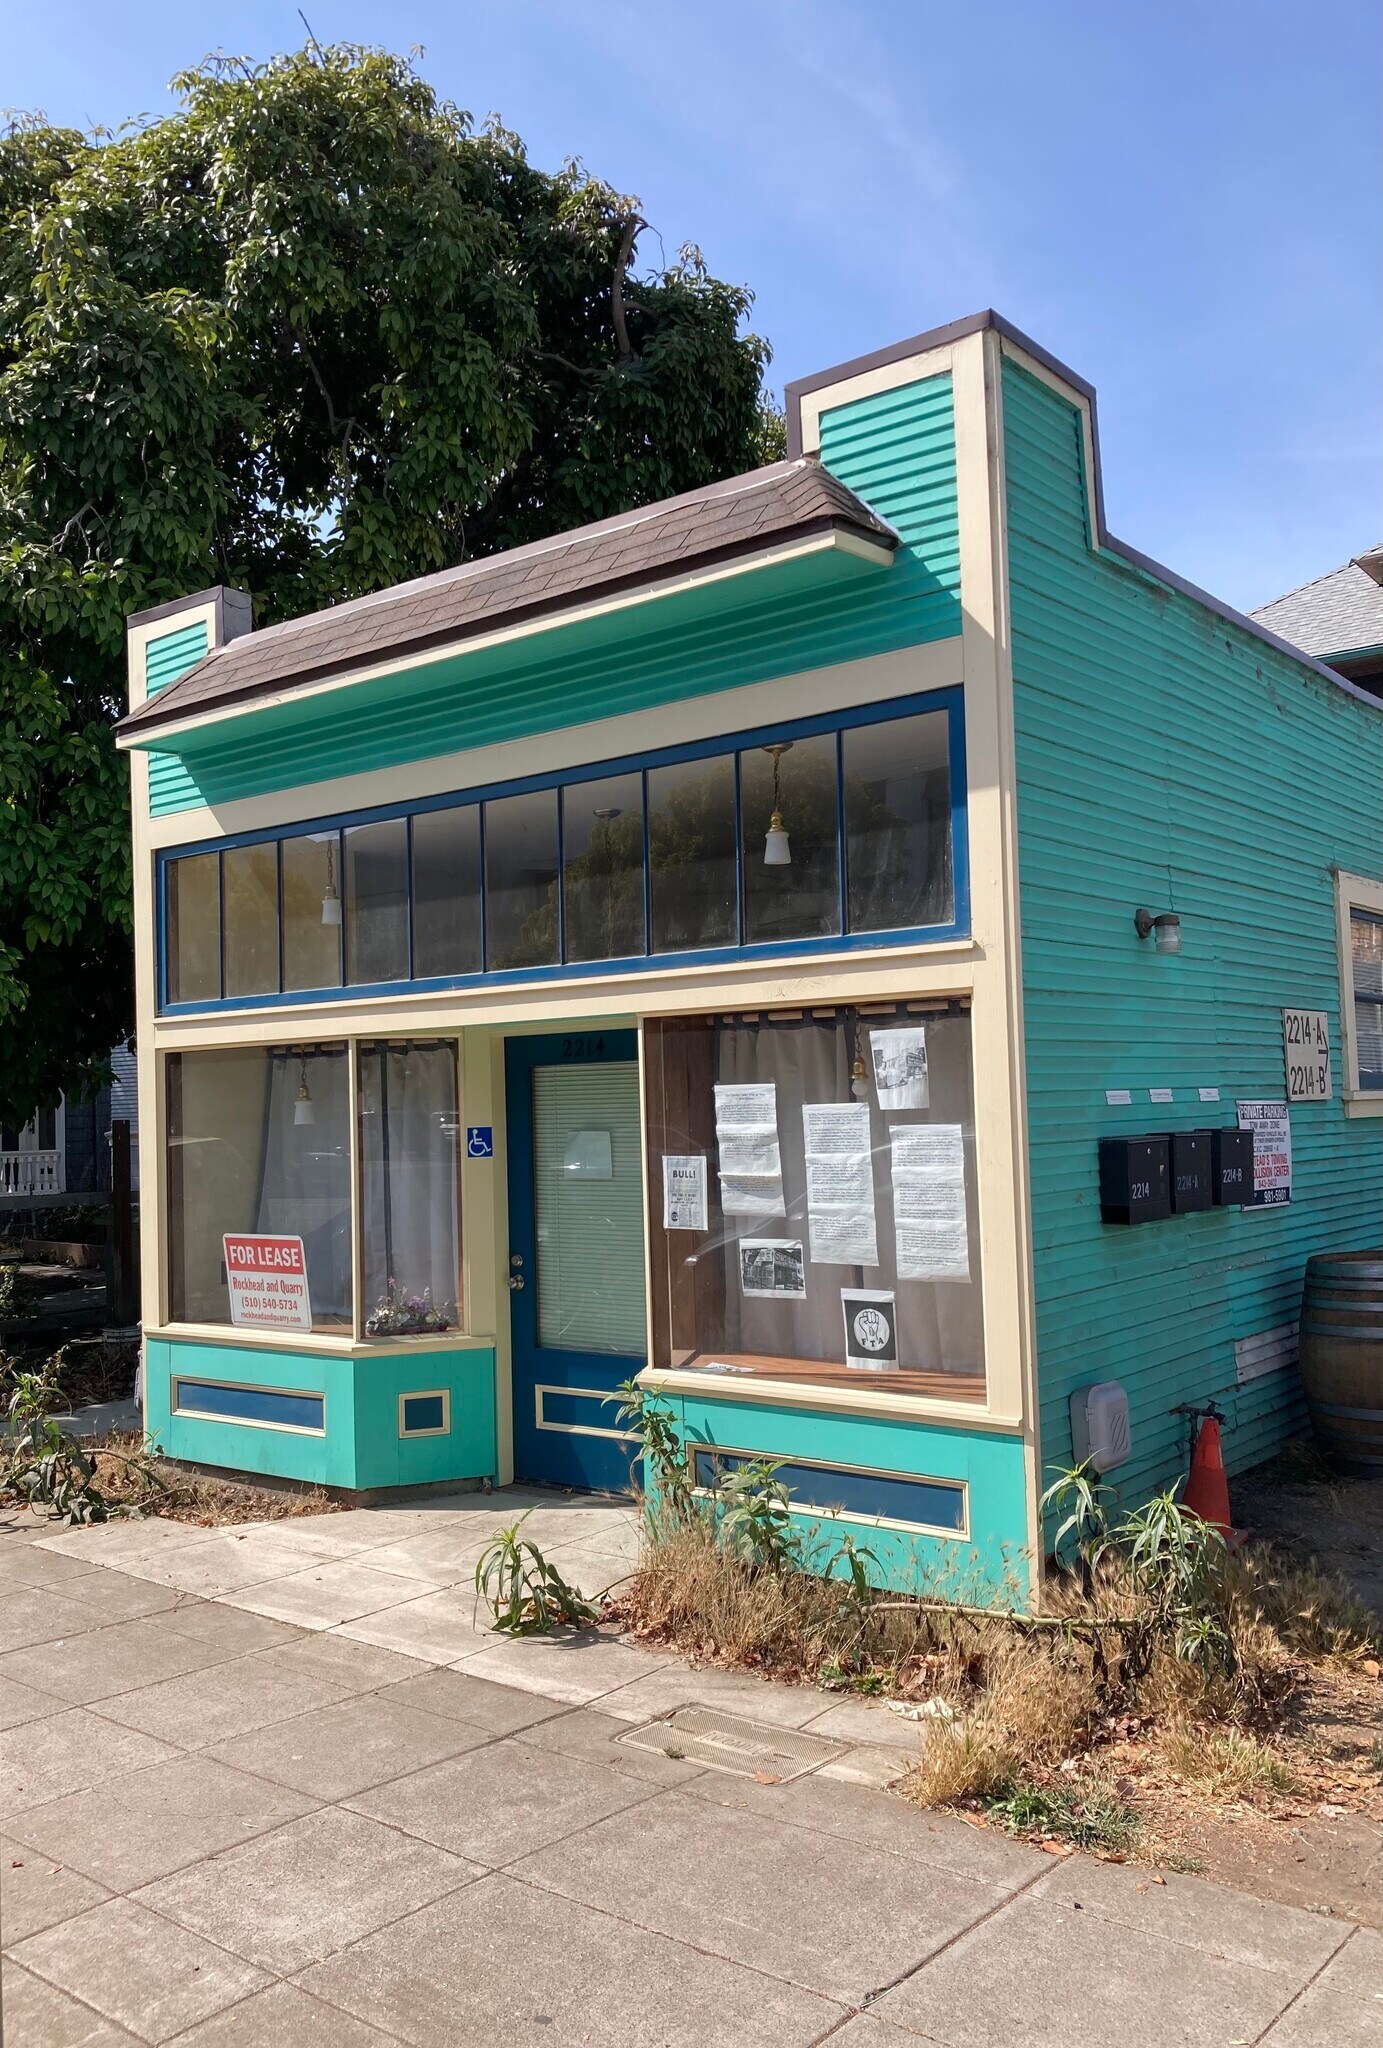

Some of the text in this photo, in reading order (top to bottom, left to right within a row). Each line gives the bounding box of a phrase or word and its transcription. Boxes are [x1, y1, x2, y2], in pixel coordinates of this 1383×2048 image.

[562, 1036, 606, 1058] 2214
[1240, 1105, 1287, 1119] PRIVATE PARKING
[1259, 1121, 1268, 1129] AWAY
[1270, 1120, 1280, 1129] ZONE
[1271, 1154, 1287, 1165] TOWING
[672, 1170, 696, 1179] BULL!
[1254, 1166, 1289, 1179] OLLISION CENTER
[1132, 1182, 1150, 1199] 2214
[229, 1245, 301, 1267] FOR LEASE
[232, 1276, 304, 1296] Rockhead and Quarry
[241, 1297, 298, 1311] (510) 540-5734
[240, 1312, 302, 1323] rockheadandquarry.com
